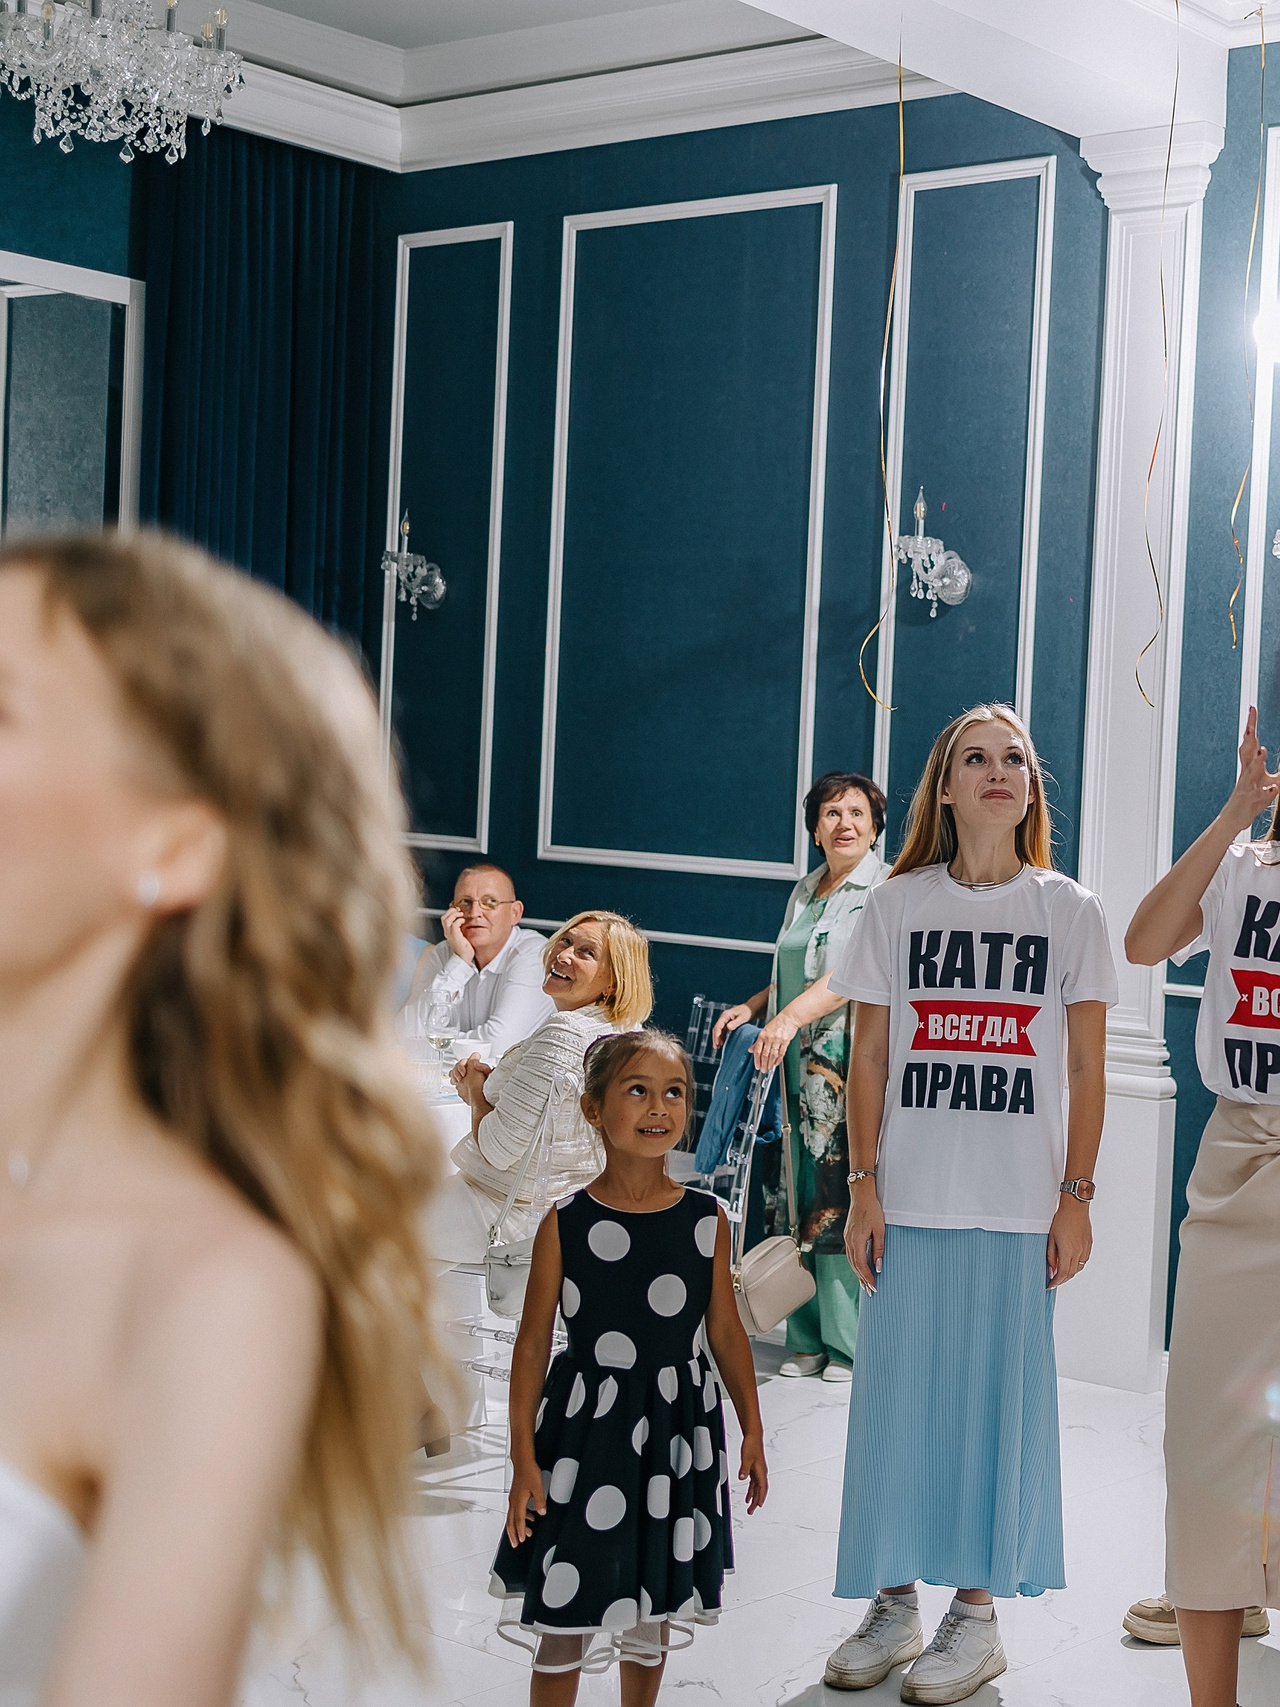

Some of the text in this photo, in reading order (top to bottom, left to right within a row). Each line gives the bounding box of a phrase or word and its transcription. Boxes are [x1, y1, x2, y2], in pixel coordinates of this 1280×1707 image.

[909, 930, 1048, 995] КАТЯ
[928, 1013, 1018, 1046] ВСЕГДА
[900, 1062, 1035, 1114] ПРАВА
